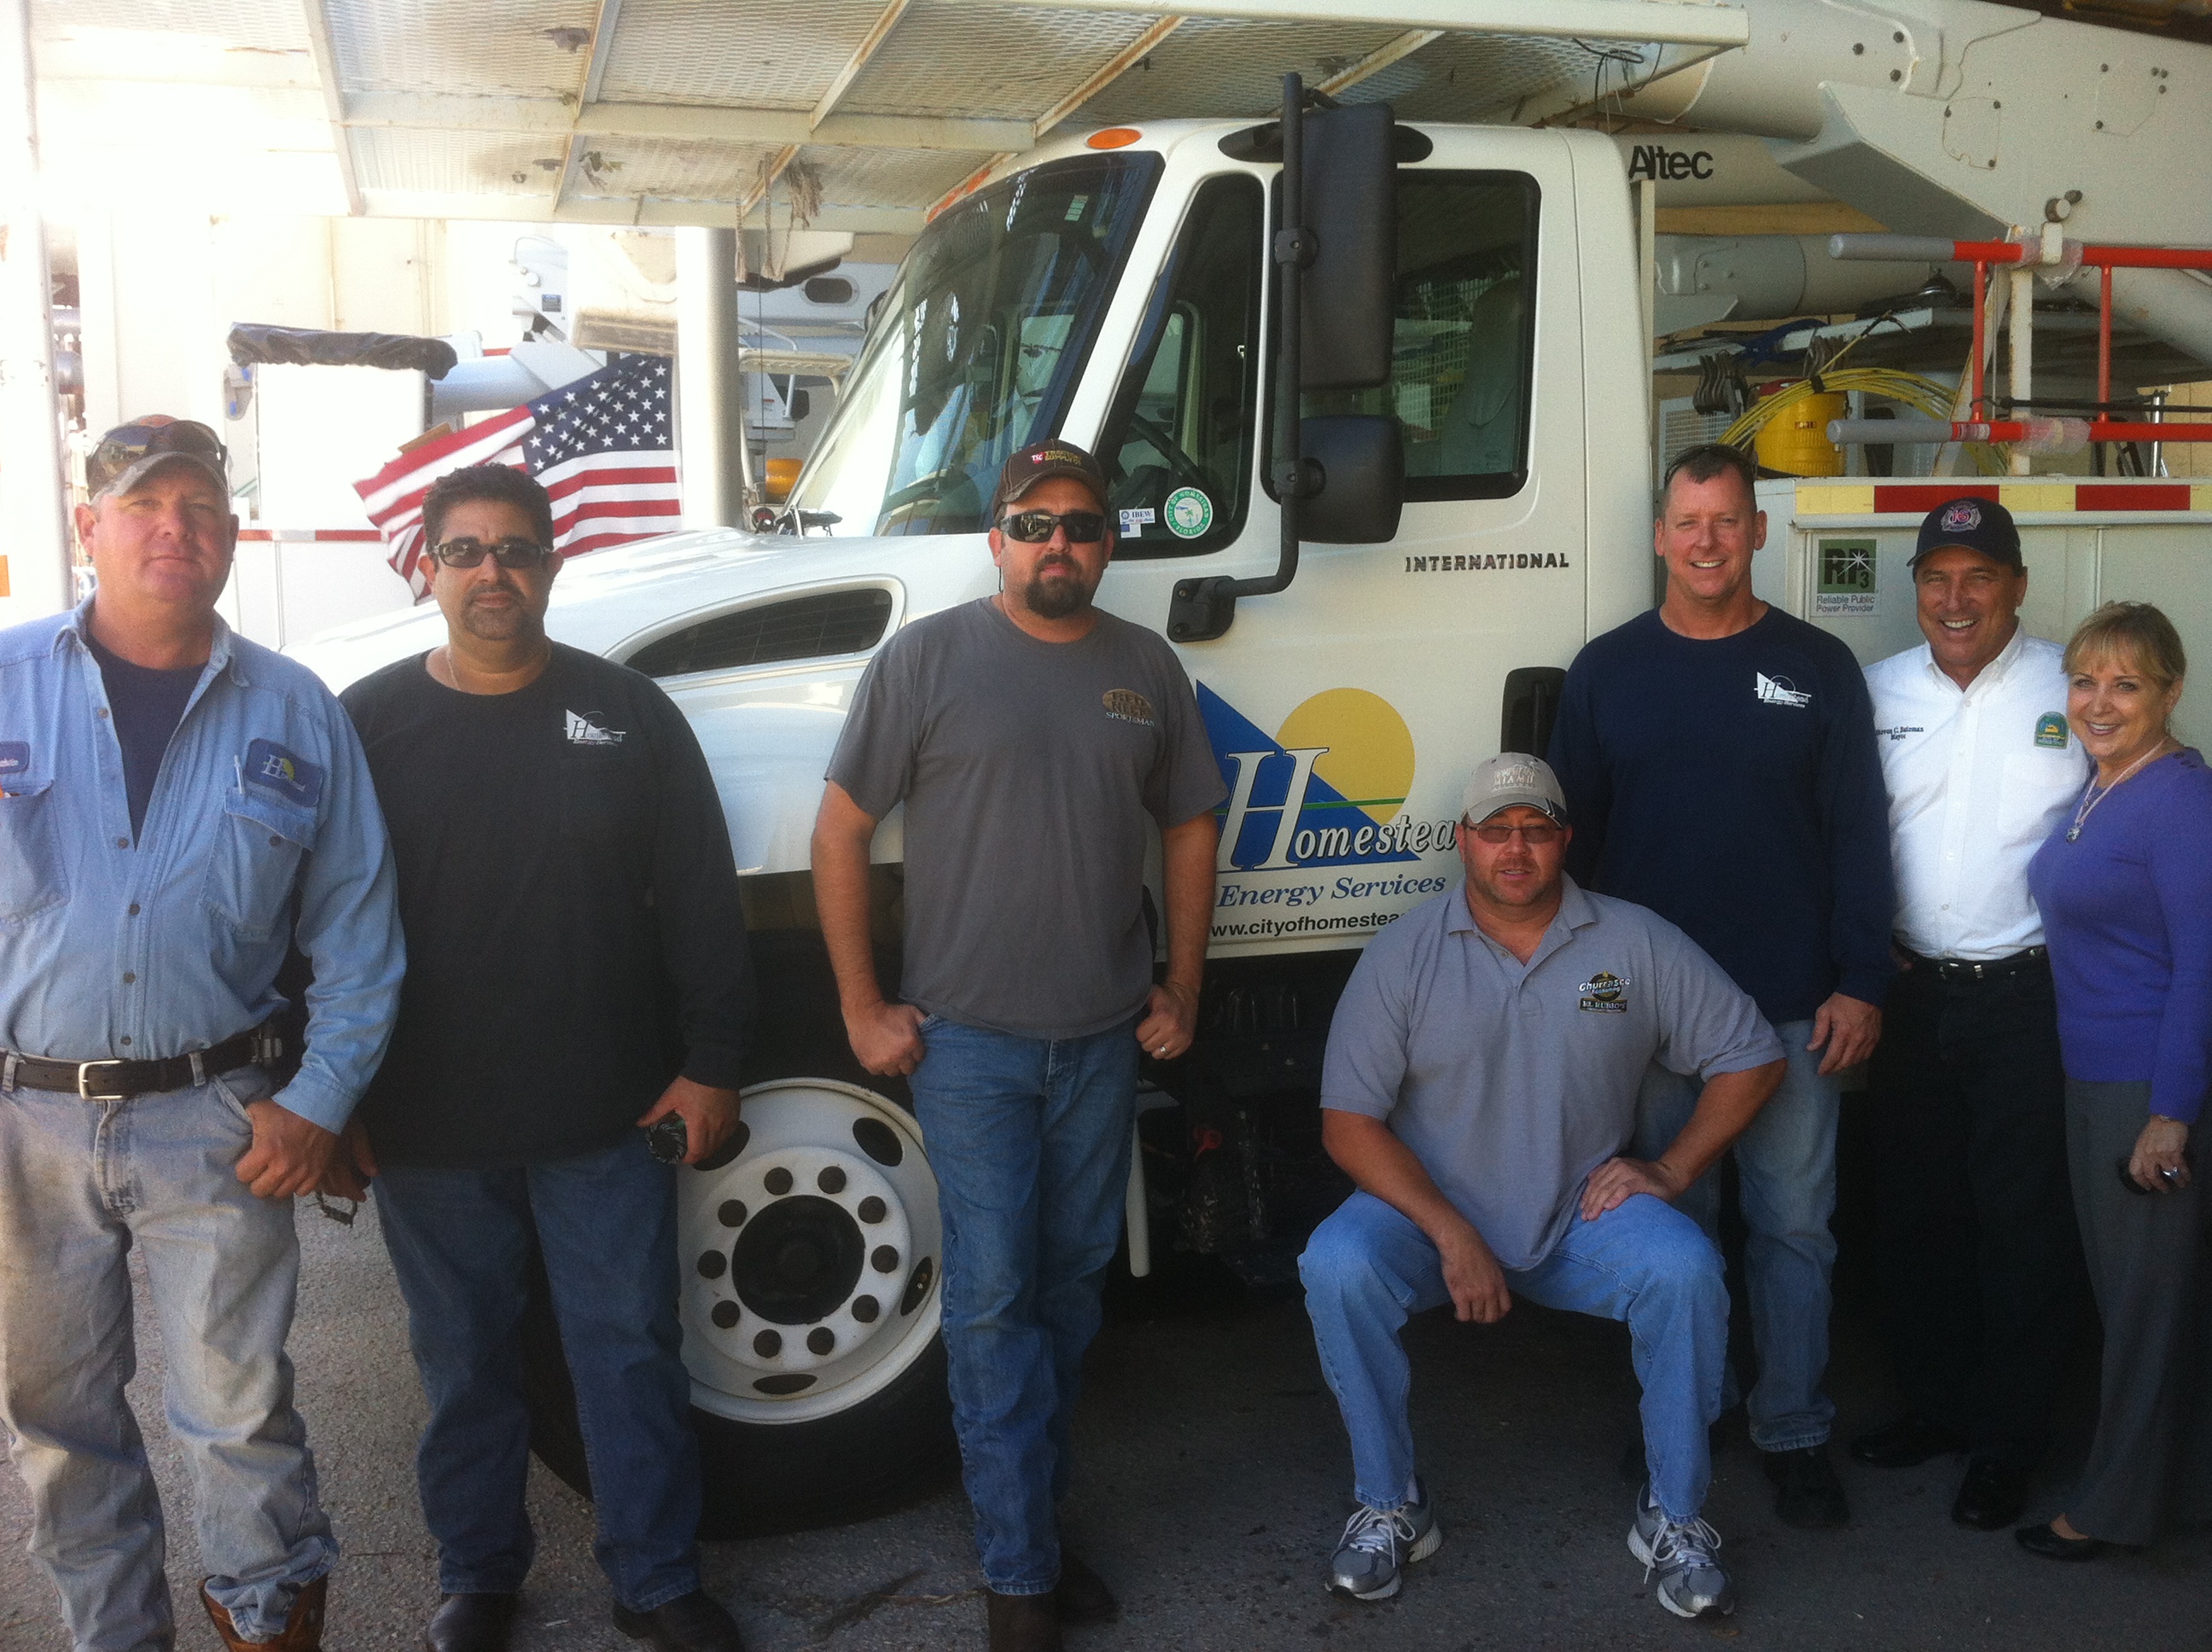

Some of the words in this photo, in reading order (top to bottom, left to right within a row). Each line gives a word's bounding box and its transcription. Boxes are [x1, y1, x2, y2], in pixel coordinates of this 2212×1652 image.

[1628, 145, 1714, 180] Altec
[1406, 553, 1569, 573] INTERNATIONAL
[1816, 595, 1849, 604] Reliable
[1851, 595, 1875, 603] Public
[1106, 711, 1155, 727] SPORTSMAN
[1215, 747, 1458, 872] Homestea
[1216, 881, 1325, 907] Energy
[1331, 874, 1447, 900] Services
[1211, 910, 1406, 937] ww.cityofhomestea
[1578, 977, 1632, 992] Churrasco
